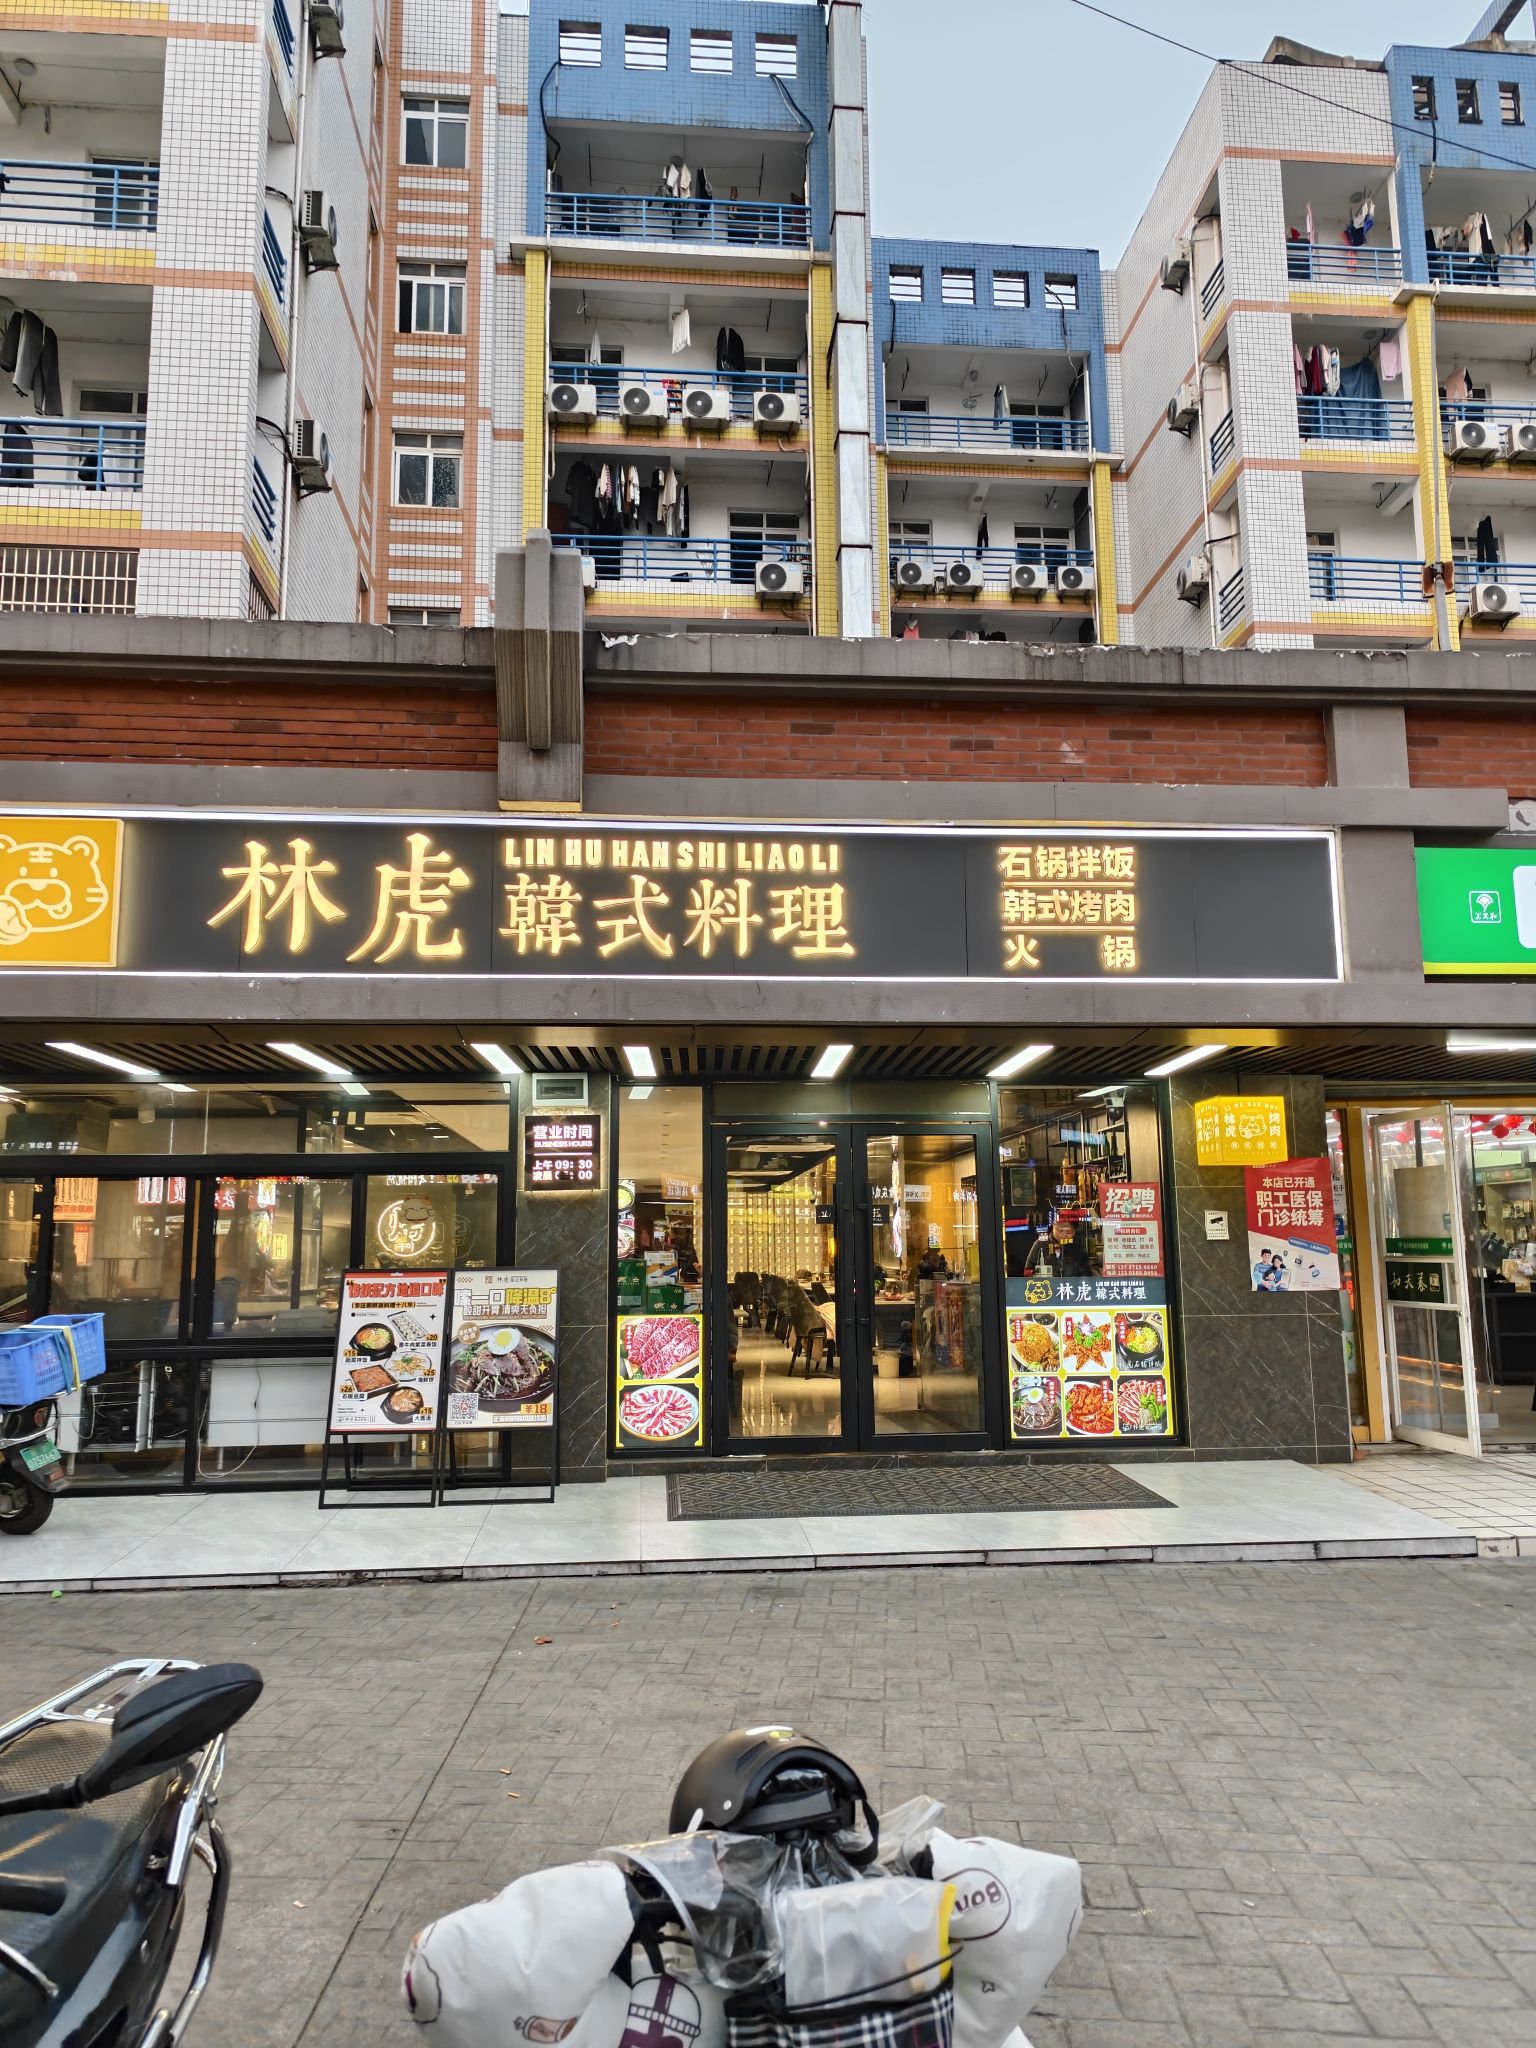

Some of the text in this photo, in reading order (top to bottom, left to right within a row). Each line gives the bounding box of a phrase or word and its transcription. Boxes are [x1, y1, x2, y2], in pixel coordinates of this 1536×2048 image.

[504, 838, 839, 872] LIN HU HAN SHI LIAO LI
[998, 845, 1136, 879] 石锅拌饭
[207, 832, 471, 964] 林虎
[1001, 888, 1136, 923] 韩式烤肉
[498, 872, 856, 958] 韓式料理
[533, 1124, 593, 1139] 营业时间
[569, 1140, 593, 1148] HOURS
[532, 1160, 553, 1170] 上午
[532, 1171, 553, 1181] 凌晨
[1262, 1176, 1316, 1189] 本店已开通
[1105, 1188, 1156, 1213] 招聘
[1255, 1190, 1324, 1209] 职工医保
[1257, 1208, 1325, 1227] 门诊统筹
[1055, 1281, 1092, 1302] 林虎
[1095, 1287, 1147, 1301] 韓式料理
[463, 1304, 547, 1315] 酸甜开胃 清爽无负担
[525, 1404, 548, 1414] ¥18
